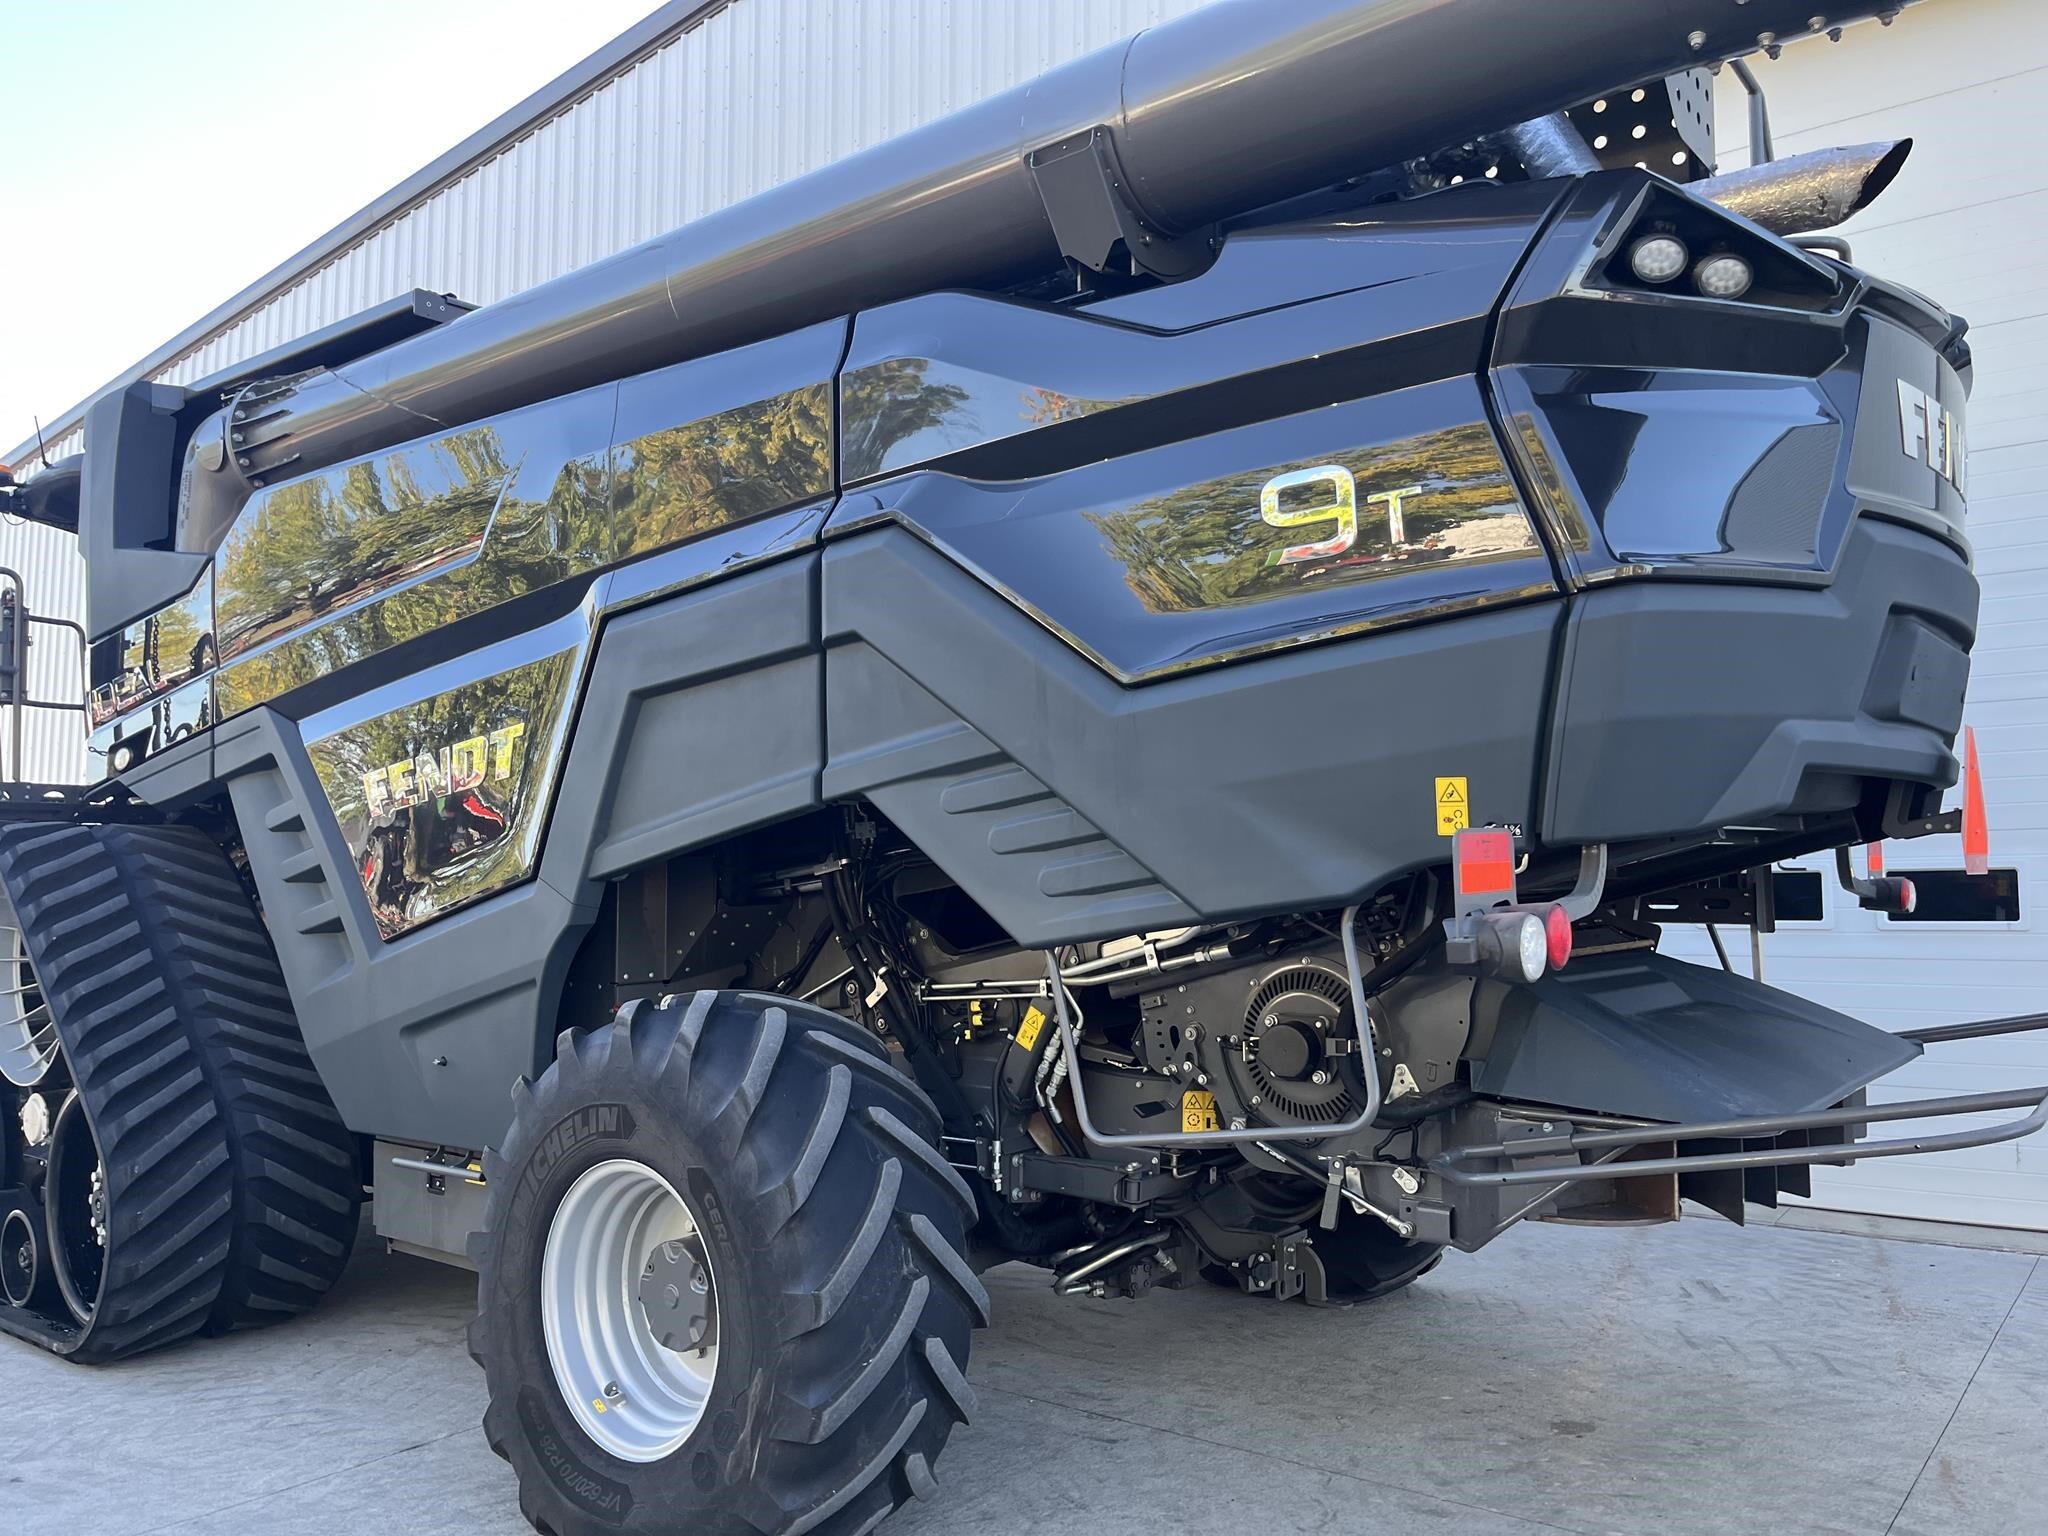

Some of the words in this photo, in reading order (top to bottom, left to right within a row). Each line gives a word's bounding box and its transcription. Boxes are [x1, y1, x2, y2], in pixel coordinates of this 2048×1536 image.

[1896, 378, 1966, 496] FEN
[362, 722, 525, 818] FENDT
[560, 1464, 602, 1500] 620/70
[601, 1493, 621, 1512] VF
